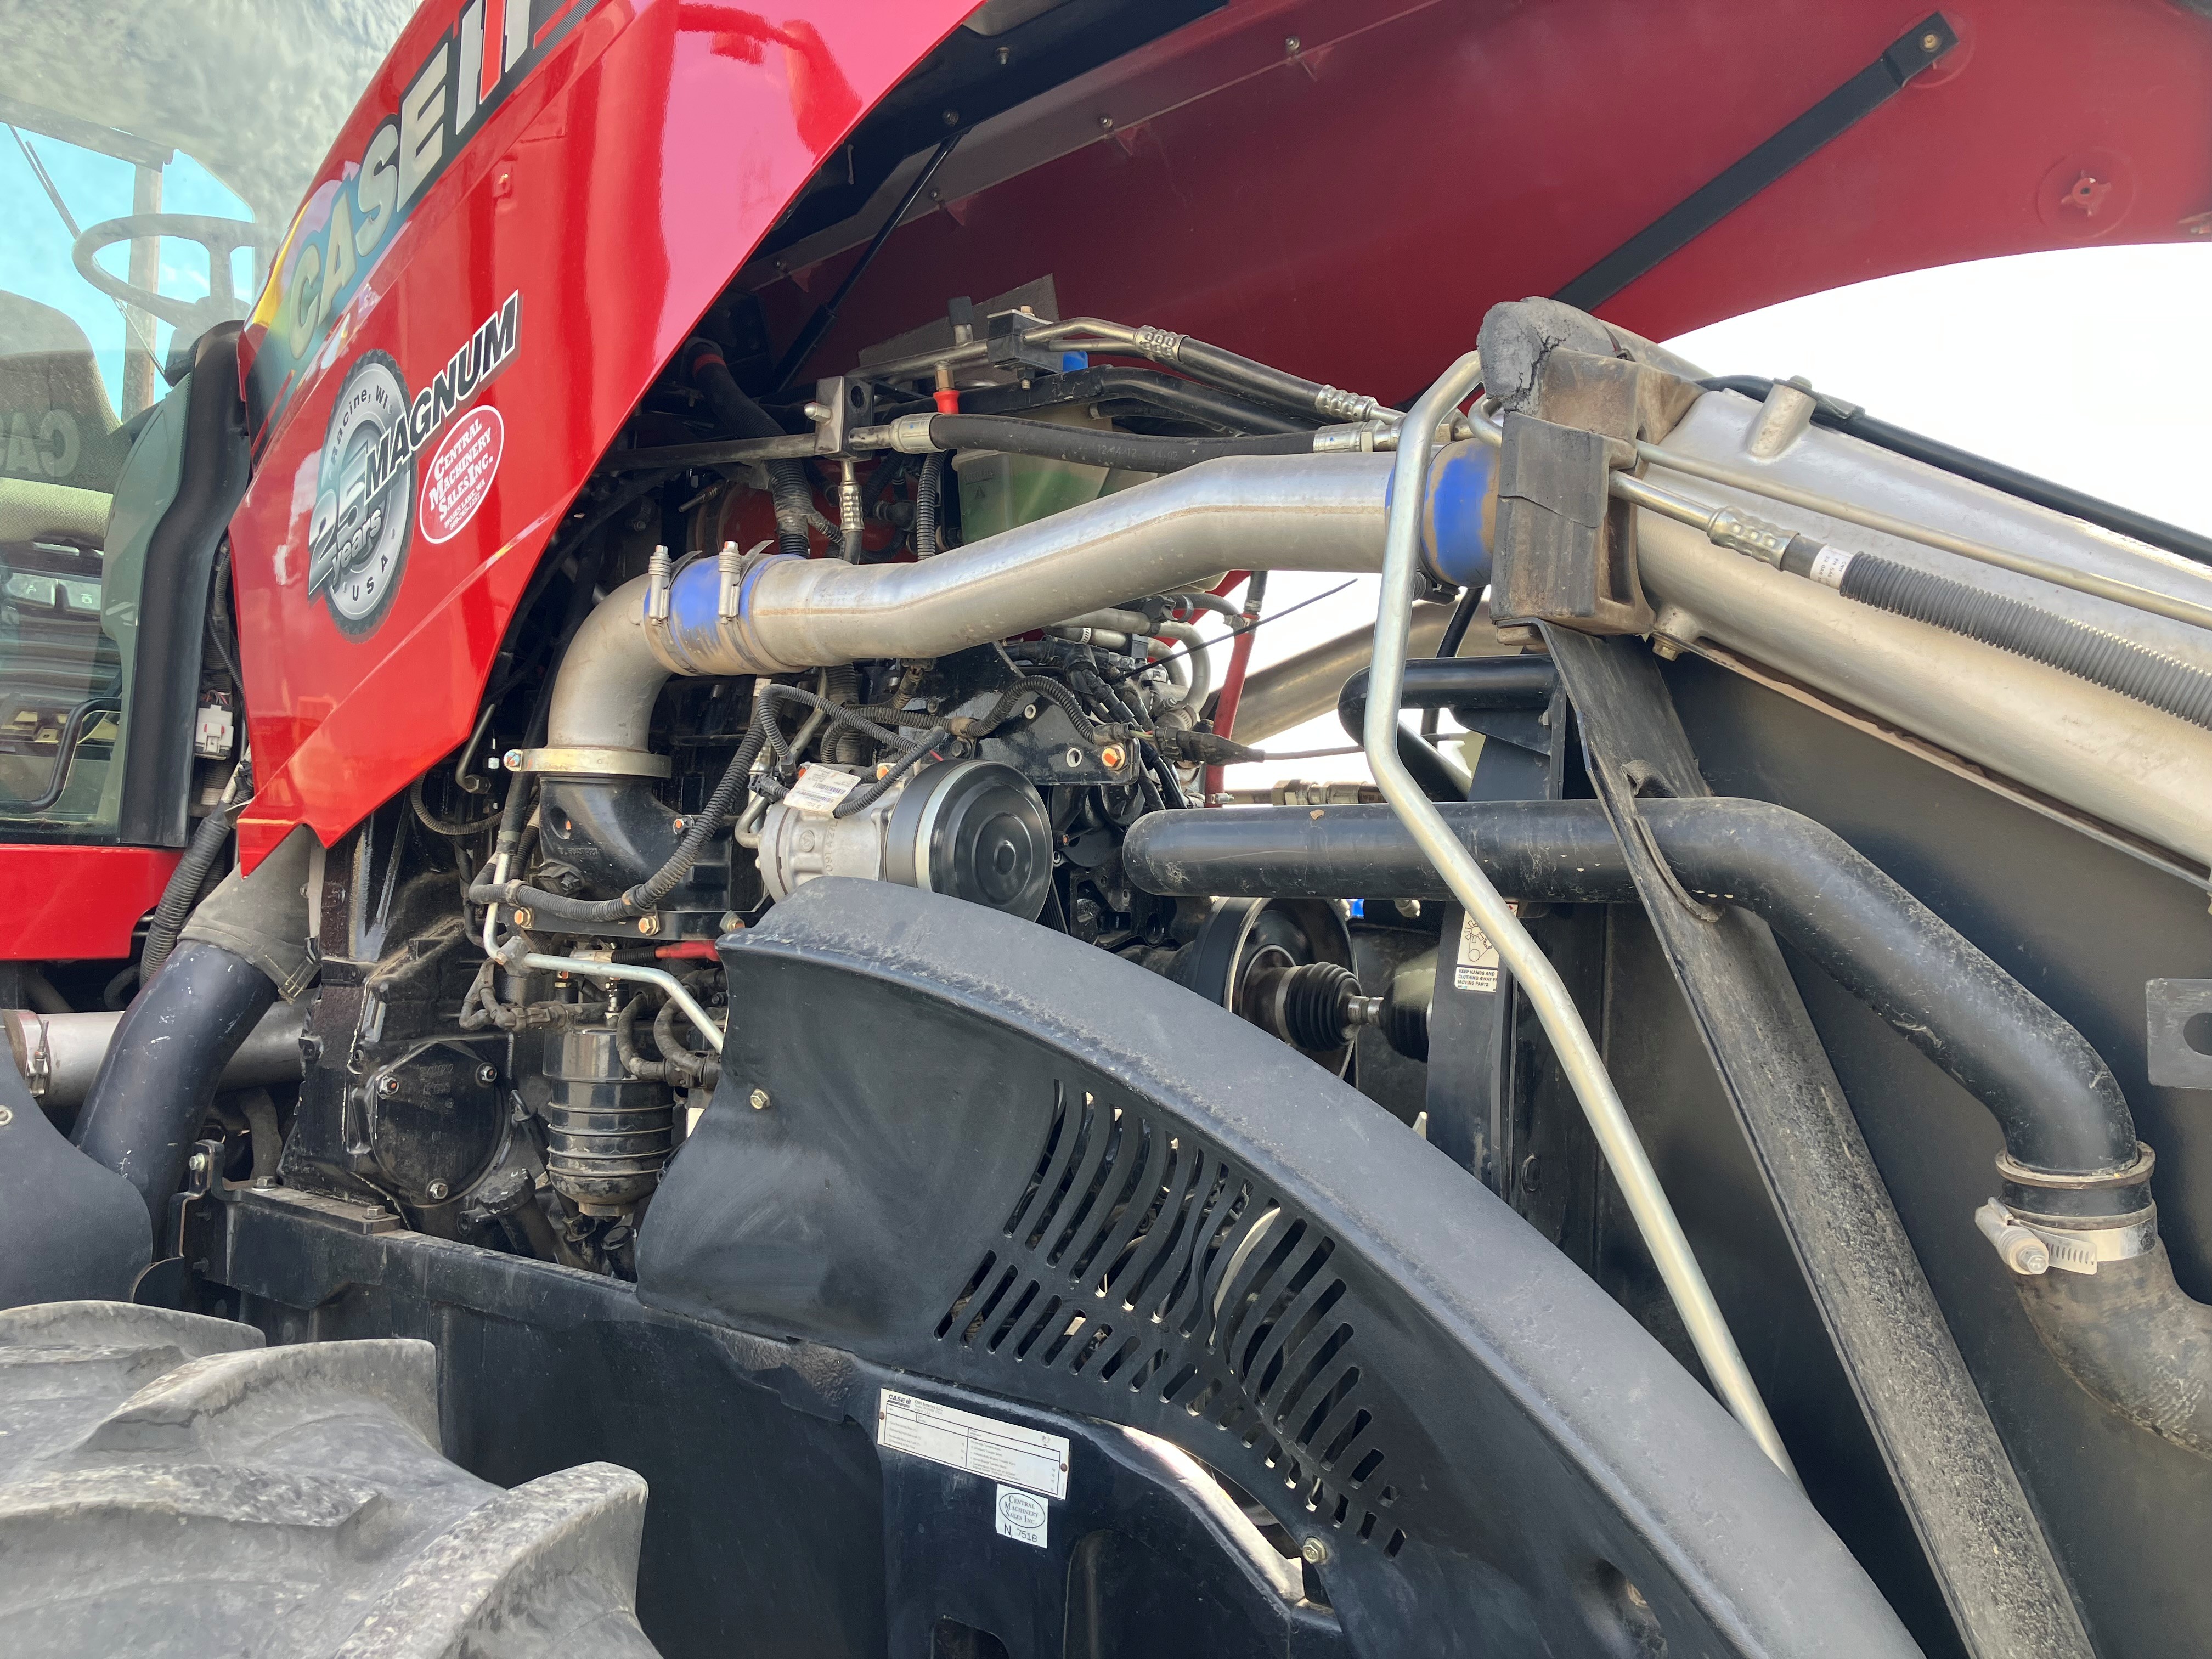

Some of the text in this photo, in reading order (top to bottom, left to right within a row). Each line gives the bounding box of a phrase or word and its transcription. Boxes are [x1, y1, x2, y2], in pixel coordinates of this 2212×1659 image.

[289, 42, 449, 360] CASE
[330, 385, 389, 466] Racine, WI
[364, 289, 518, 506] MAGNUM
[429, 426, 492, 511] MACHINERY
[434, 417, 482, 481] CENTRAL
[308, 445, 369, 595] 25
[439, 453, 494, 522] SALES INC.
[444, 506, 461, 529] MOSES
[476, 478, 486, 493] WA
[332, 509, 382, 587] years
[888, 1394, 905, 1403] CASE
[1005, 1501, 1039, 1517] MACHINERY
[1006, 1509, 1023, 1521] SALES
[1009, 1495, 1036, 1509] CENTRAL
[1017, 1528, 1037, 1543] 7518
